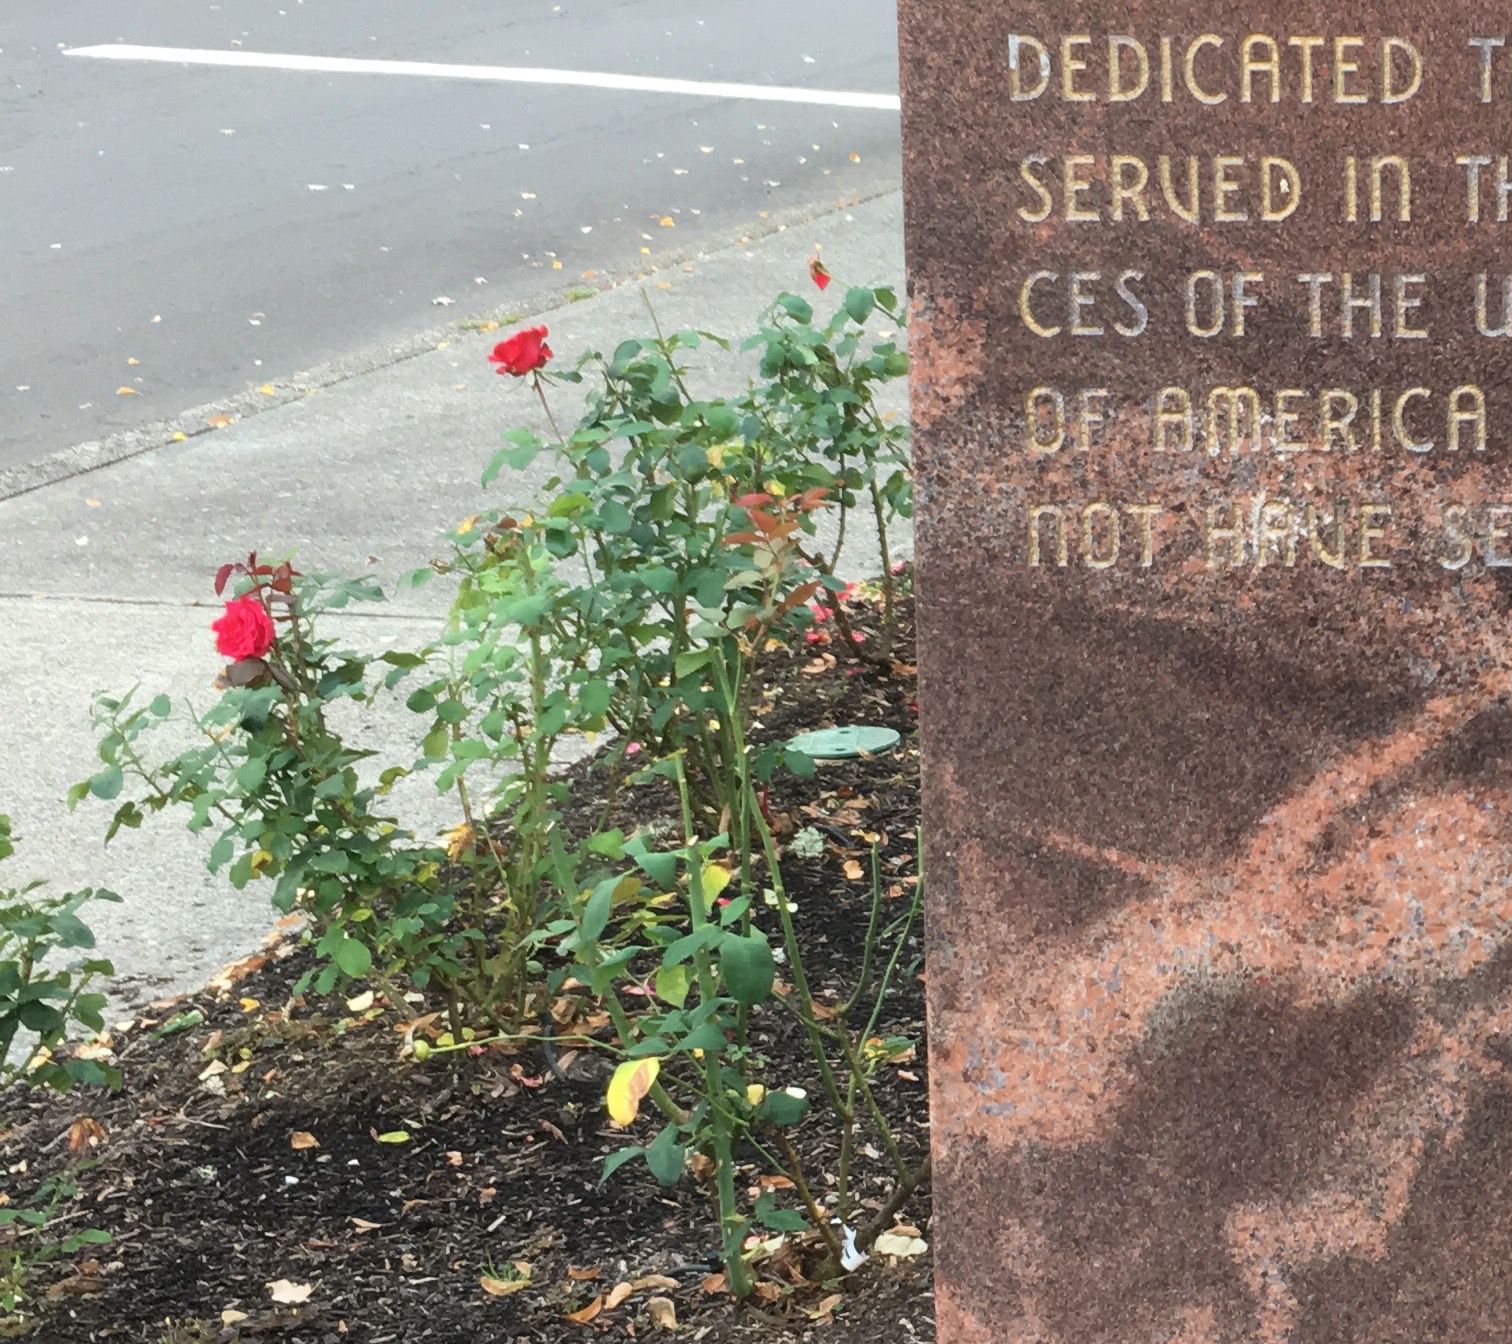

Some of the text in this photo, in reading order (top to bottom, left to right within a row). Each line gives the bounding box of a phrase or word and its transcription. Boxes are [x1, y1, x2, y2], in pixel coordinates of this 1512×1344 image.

[1008, 33, 1422, 104] DEDICATED
[1017, 155, 1301, 224] SERVED
[1345, 155, 1411, 222] IN
[1019, 270, 1149, 337] CES
[1185, 269, 1264, 337] OF
[1299, 271, 1428, 338] THE
[1025, 386, 1108, 453] OF
[1154, 385, 1486, 455] AMERICA
[1029, 503, 1163, 569] NOT
[1205, 502, 1393, 570] HAVE
